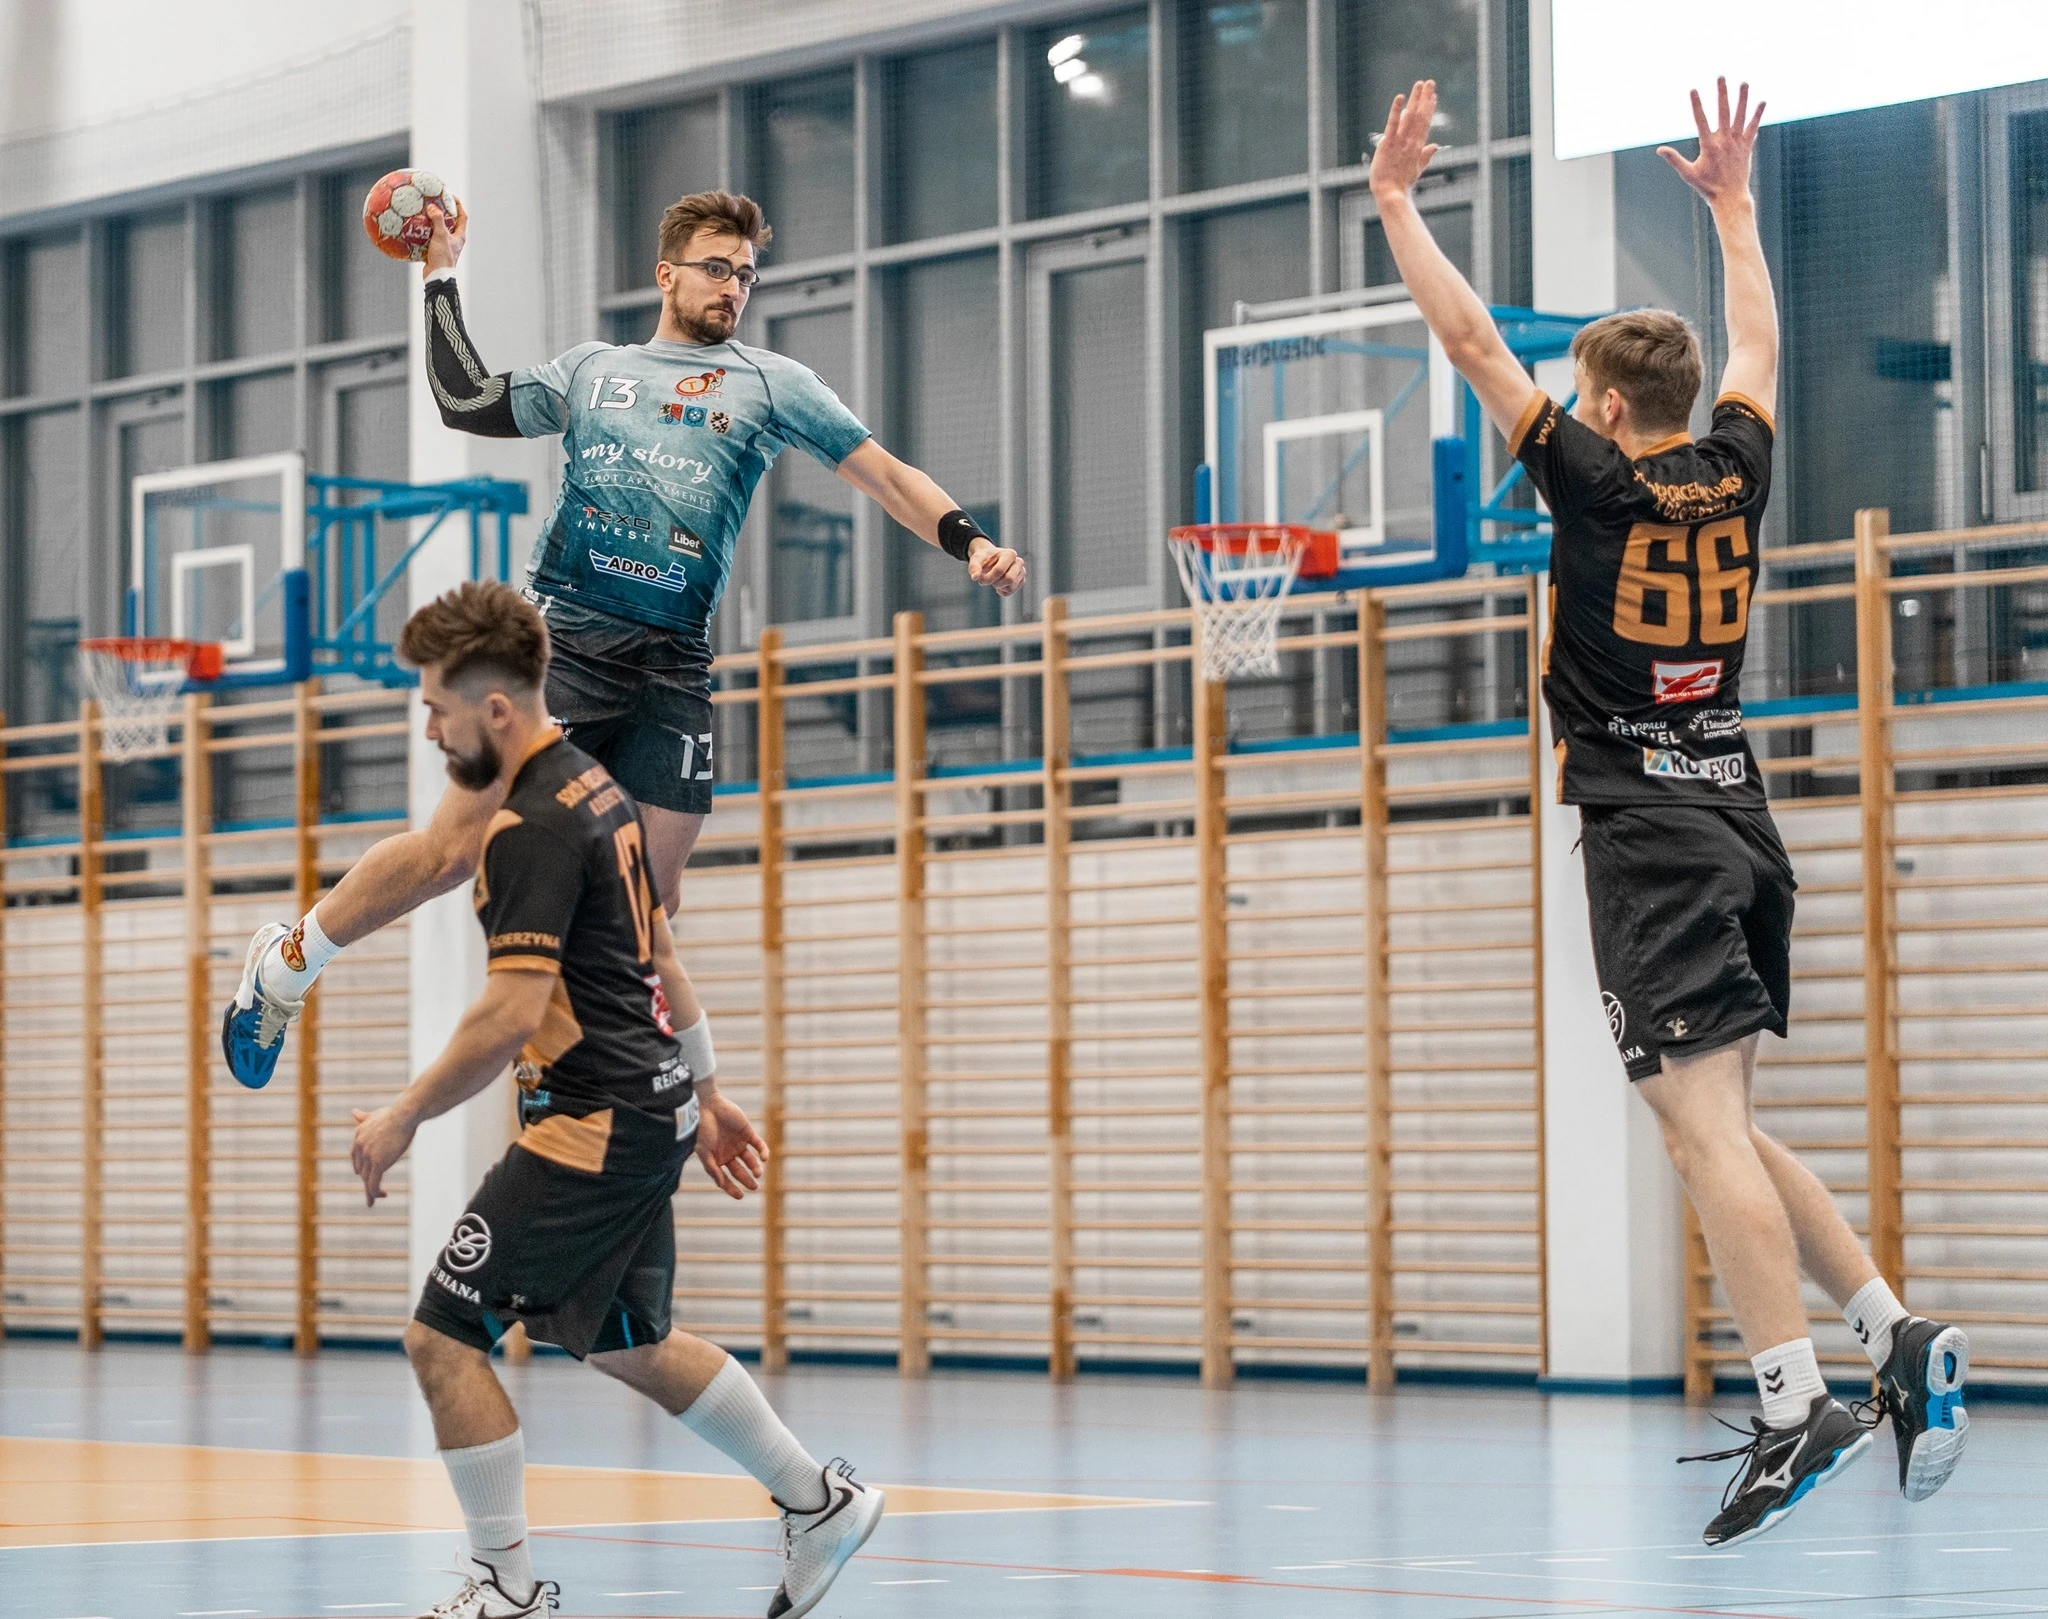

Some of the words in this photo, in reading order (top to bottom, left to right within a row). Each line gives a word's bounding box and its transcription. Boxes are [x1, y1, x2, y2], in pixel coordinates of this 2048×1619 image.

[588, 376, 644, 411] 13
[582, 443, 626, 465] my
[632, 443, 713, 484] story
[582, 506, 652, 531] TEXO
[577, 520, 650, 543] INVEST
[674, 531, 701, 549] Libet
[607, 556, 659, 580] ADRO
[1613, 516, 1751, 647] 66
